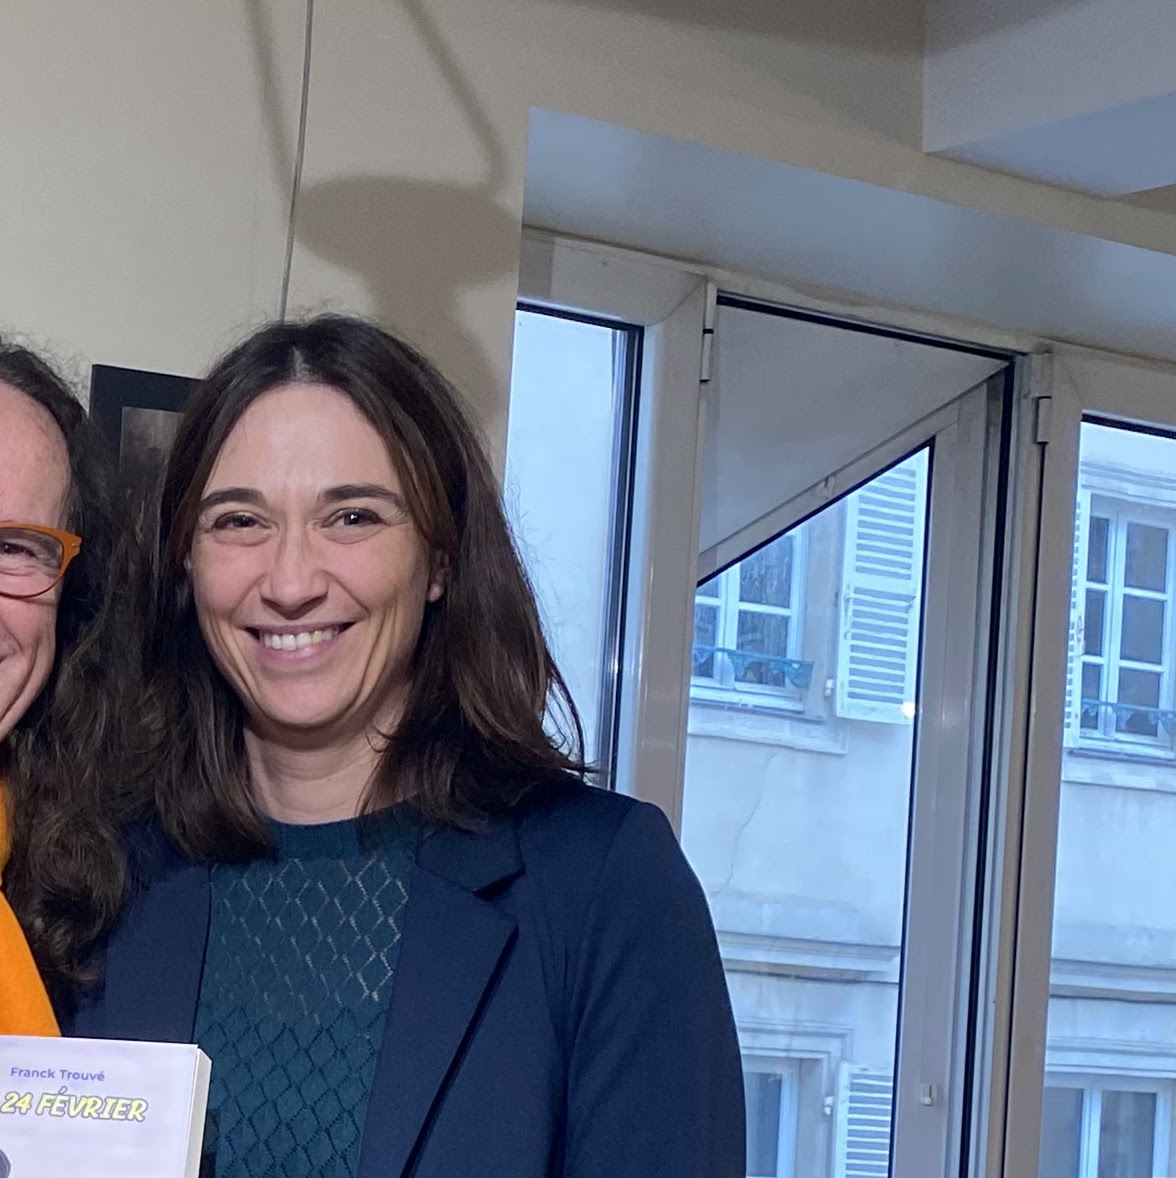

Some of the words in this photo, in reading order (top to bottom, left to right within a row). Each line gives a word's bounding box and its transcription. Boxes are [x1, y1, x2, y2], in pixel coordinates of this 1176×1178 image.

[10, 1066, 55, 1079] Franck
[59, 1069, 105, 1082] Trouvé
[0, 1091, 34, 1115] 24
[35, 1086, 149, 1122] FÉVRIER
